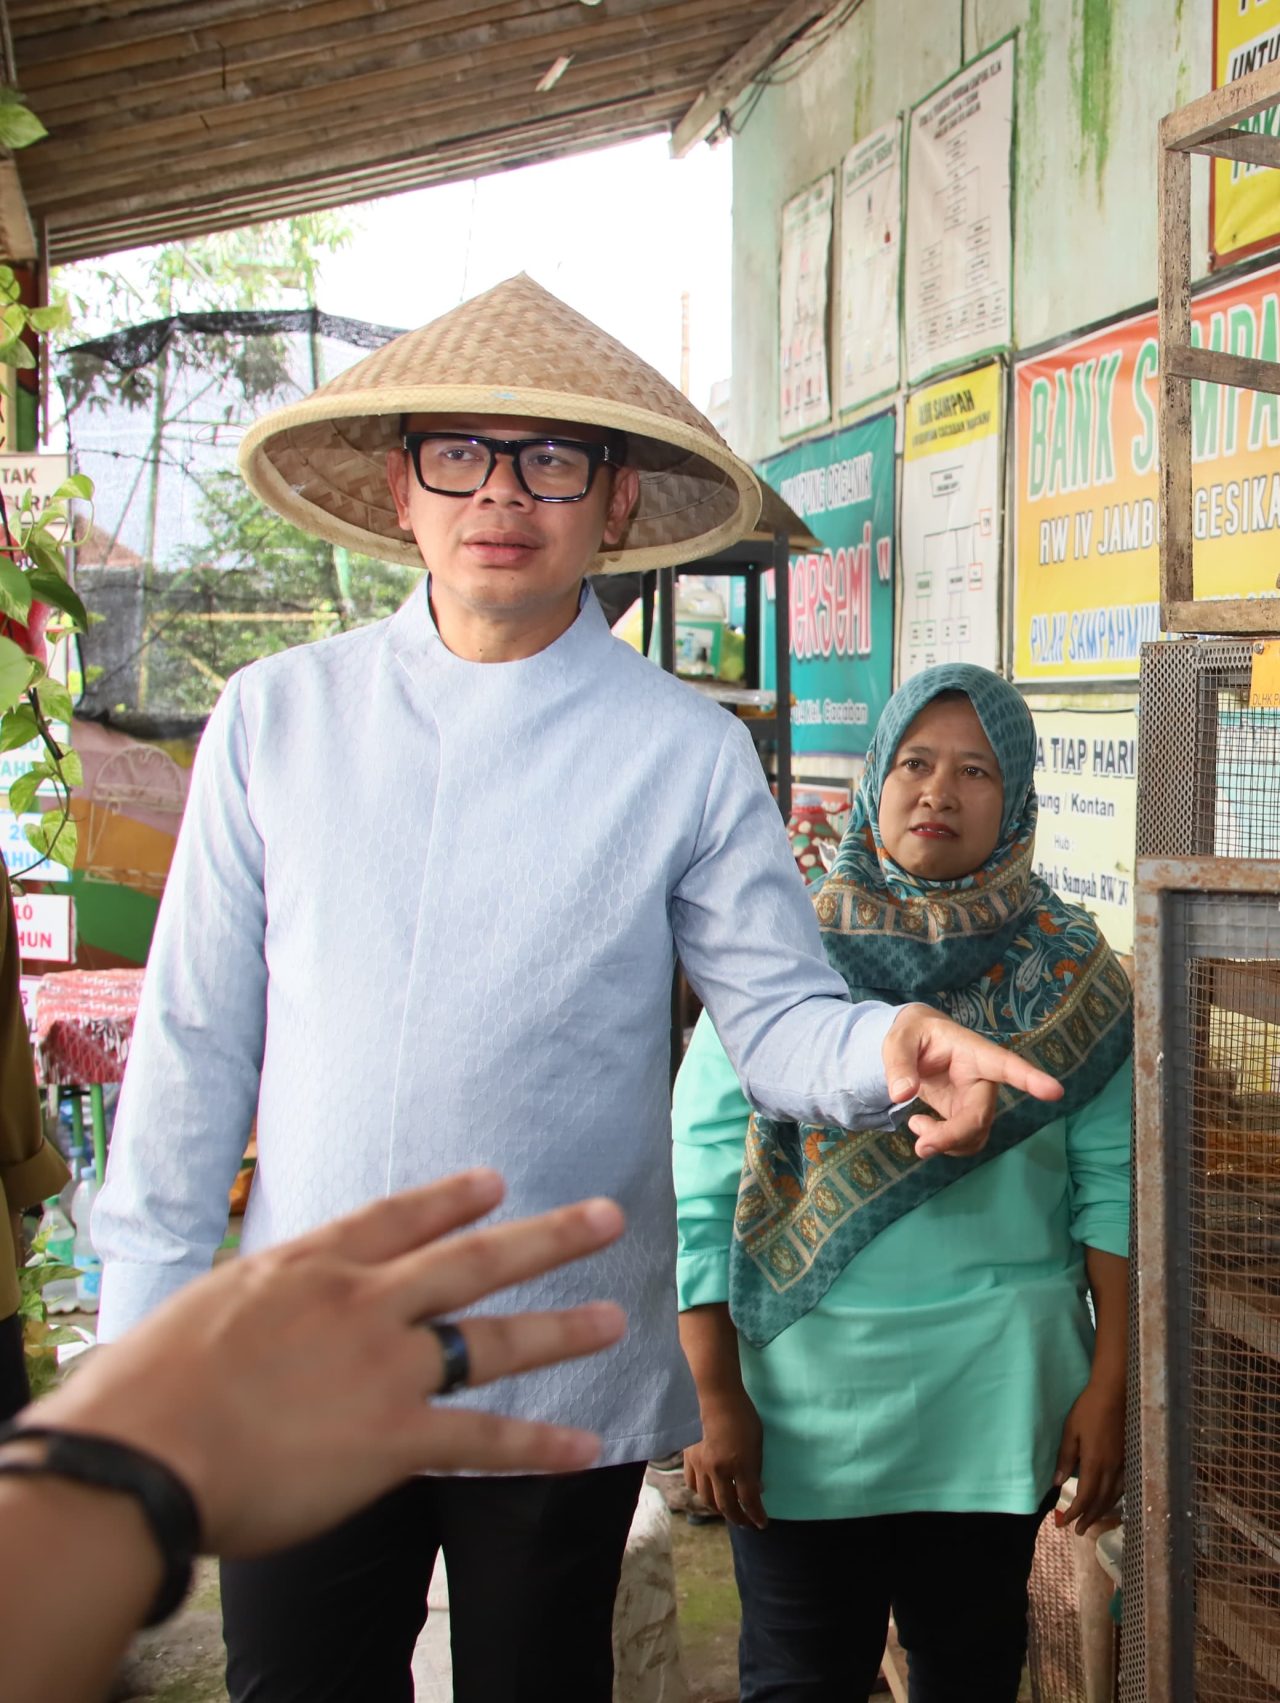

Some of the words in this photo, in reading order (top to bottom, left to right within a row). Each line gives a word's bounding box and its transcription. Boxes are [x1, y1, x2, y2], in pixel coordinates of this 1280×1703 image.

[1029, 351, 1122, 502] BANK
[1040, 515, 1070, 565] RW
[1073, 509, 1094, 560] IV
[1252, 692, 1273, 706] DLHK
[1051, 737, 1086, 774] TIAP
[1093, 739, 1136, 779] HARI
[1071, 793, 1115, 818] Kontan
[1062, 867, 1097, 902] Sampah
